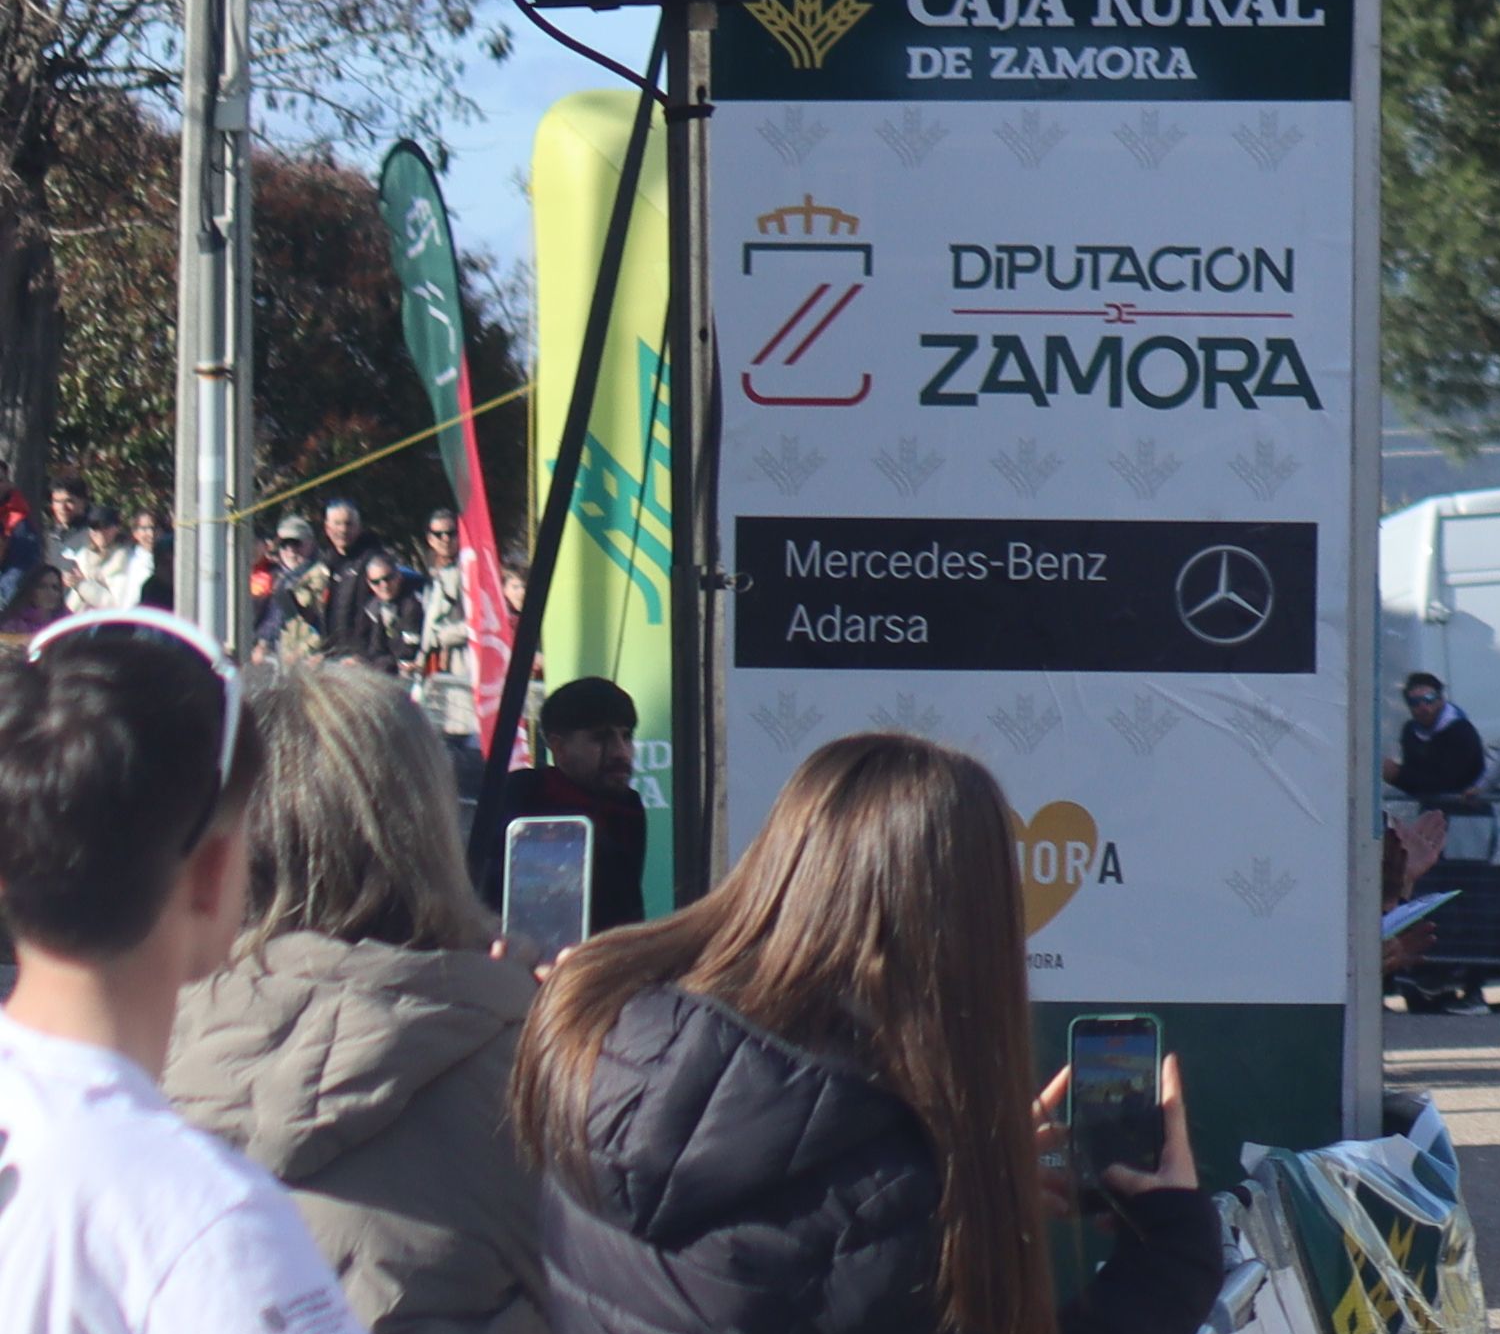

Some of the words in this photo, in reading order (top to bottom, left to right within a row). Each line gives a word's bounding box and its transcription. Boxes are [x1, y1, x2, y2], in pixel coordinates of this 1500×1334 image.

[907, 47, 971, 79] DE
[990, 46, 1196, 79] ZAMORA
[919, 334, 1323, 410] ZAMORA
[786, 540, 1106, 580] Mercedes-Benz
[787, 604, 927, 643] Adarsa
[1016, 840, 1124, 885] ORA
